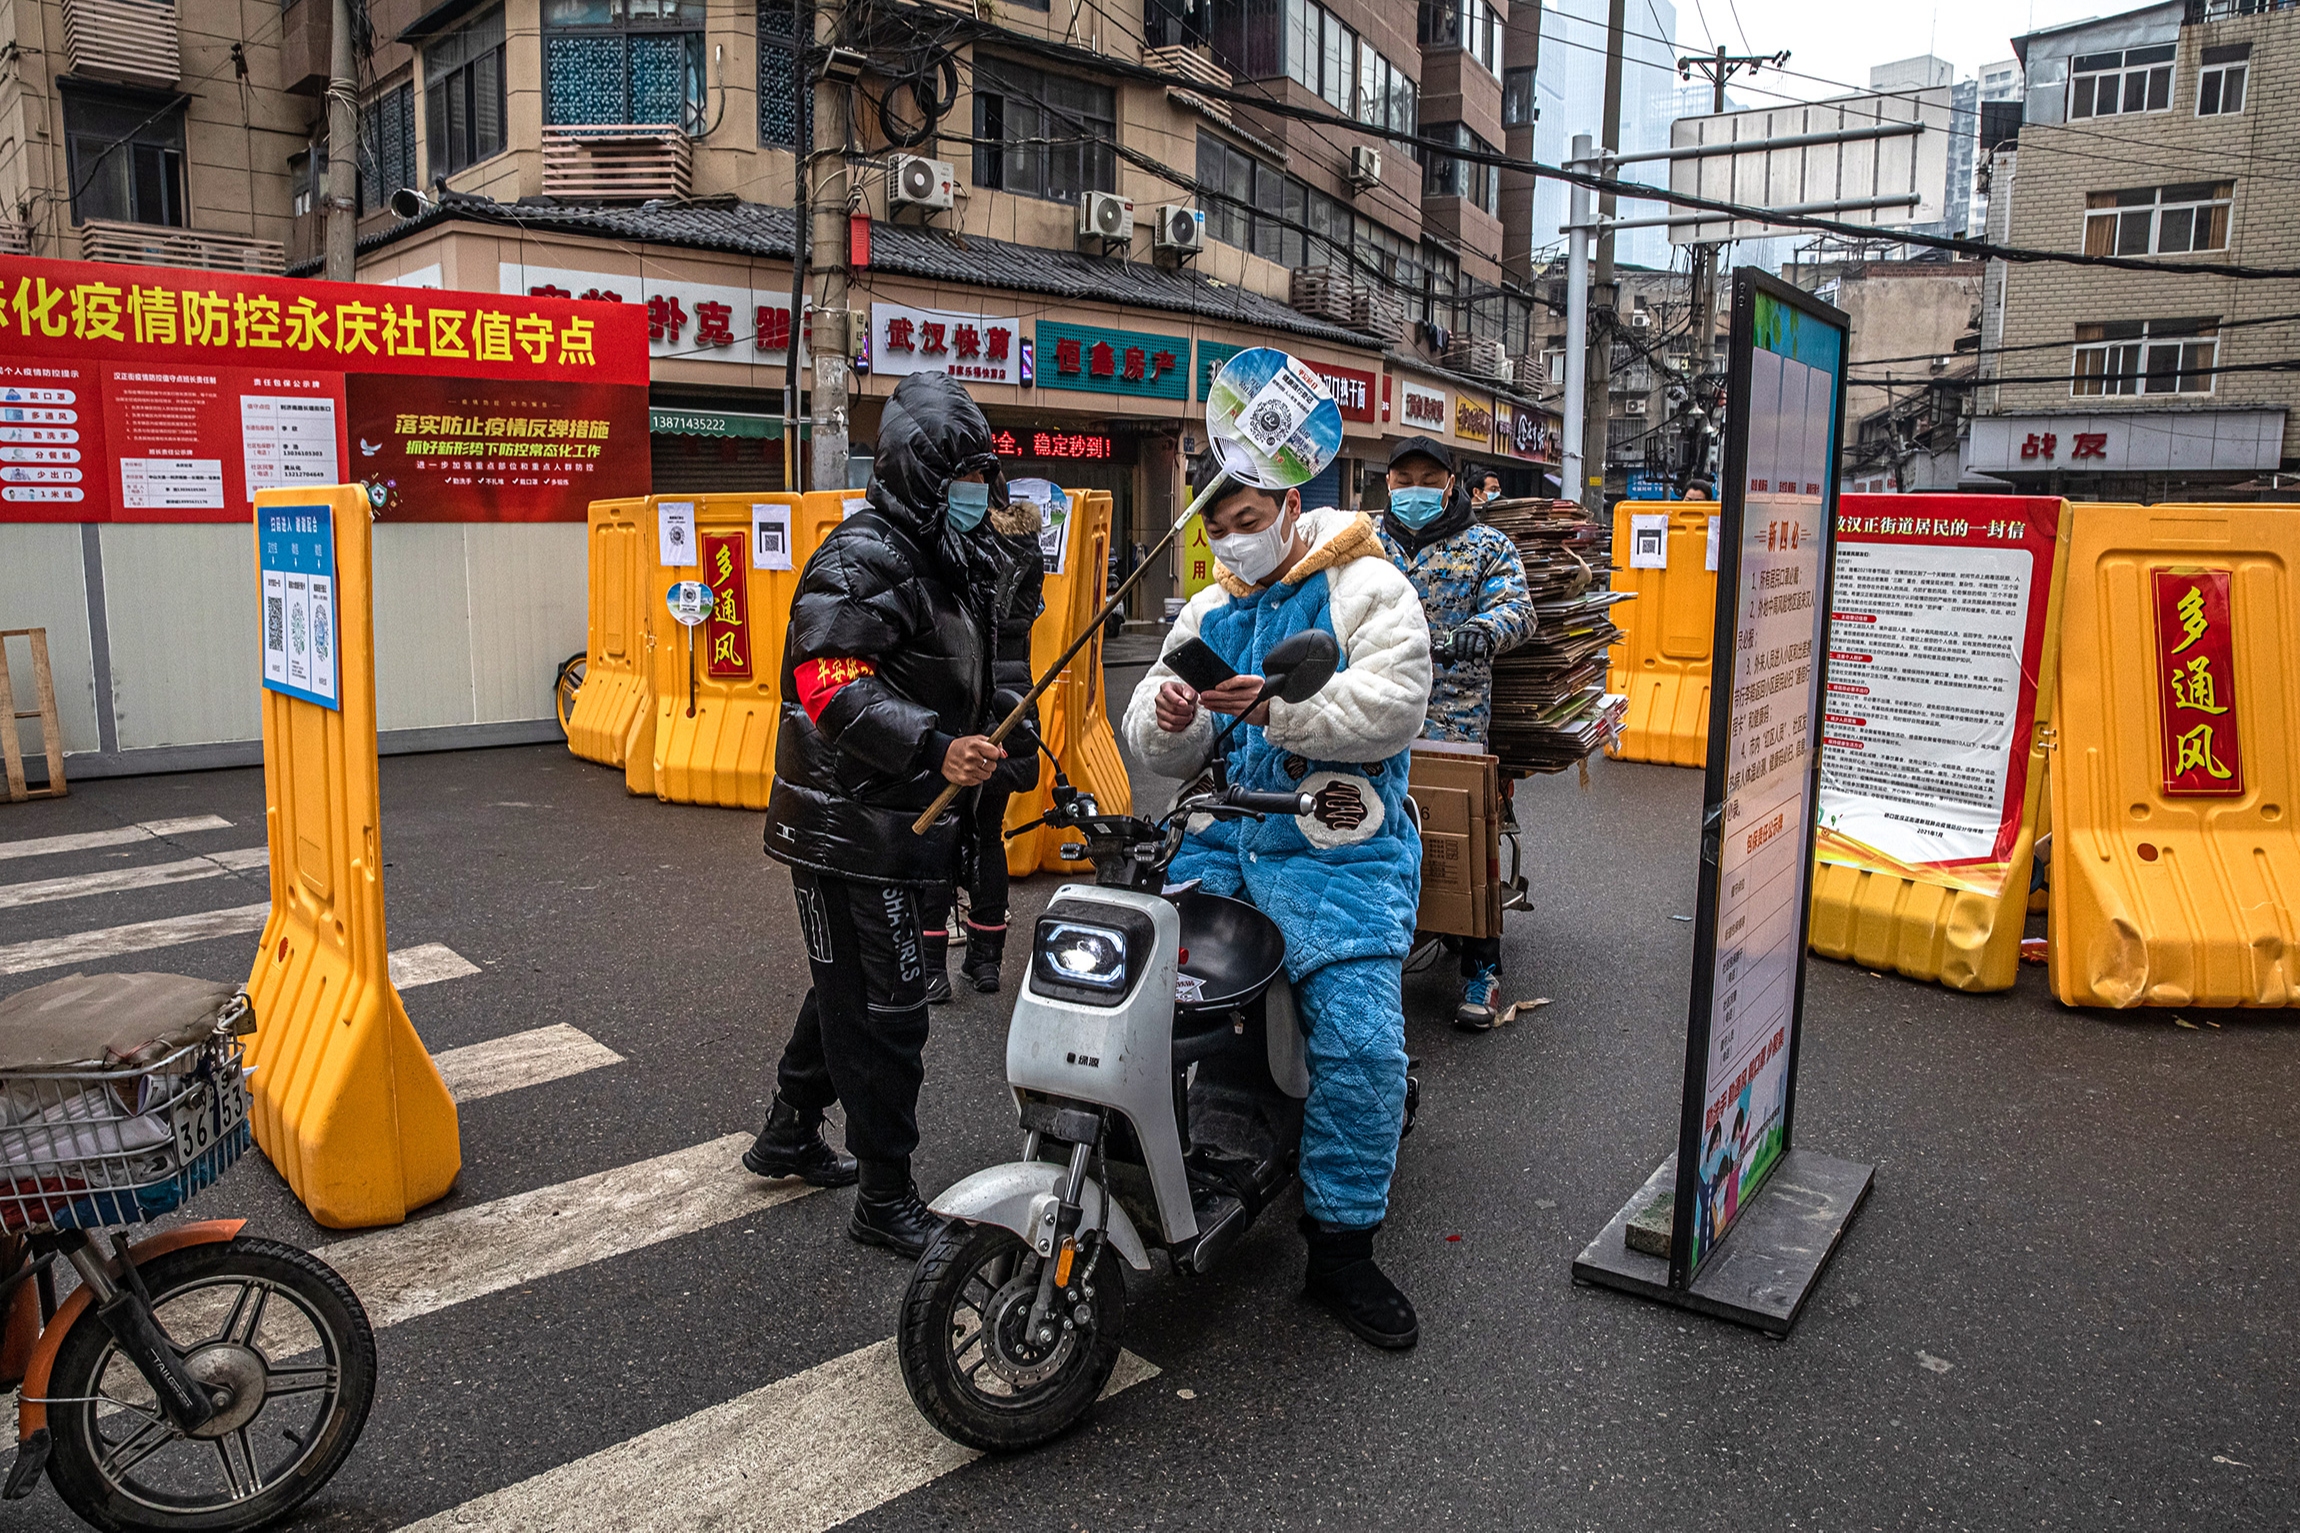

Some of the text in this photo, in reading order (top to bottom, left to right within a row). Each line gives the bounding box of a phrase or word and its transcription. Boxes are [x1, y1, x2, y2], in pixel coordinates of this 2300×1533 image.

[0, 276, 596, 366] 化疫情防控永庆社区值守点
[884, 317, 1012, 360] 武汉快剪
[1056, 337, 1177, 382] 恒鑫房产
[31, 411, 67, 420] 多通风
[394, 414, 610, 440] 落实防止疫情反弹措施
[652, 416, 726, 432] 13871435222
[405, 440, 601, 459] 抓好新形势下防控常态化工作
[2020, 432, 2107, 460] 战友
[37, 471, 73, 480] 少出门
[416, 460, 594, 472] 进一步加强重点部位和重点人群防控
[41, 490, 73, 499] 1米线
[1768, 520, 1799, 552] 新四必
[712, 544, 743, 667] 多通风
[2171, 585, 2233, 780] 多通风
[1917, 828, 1943, 839] 2021年1月
[180, 1083, 243, 1158] 3653
